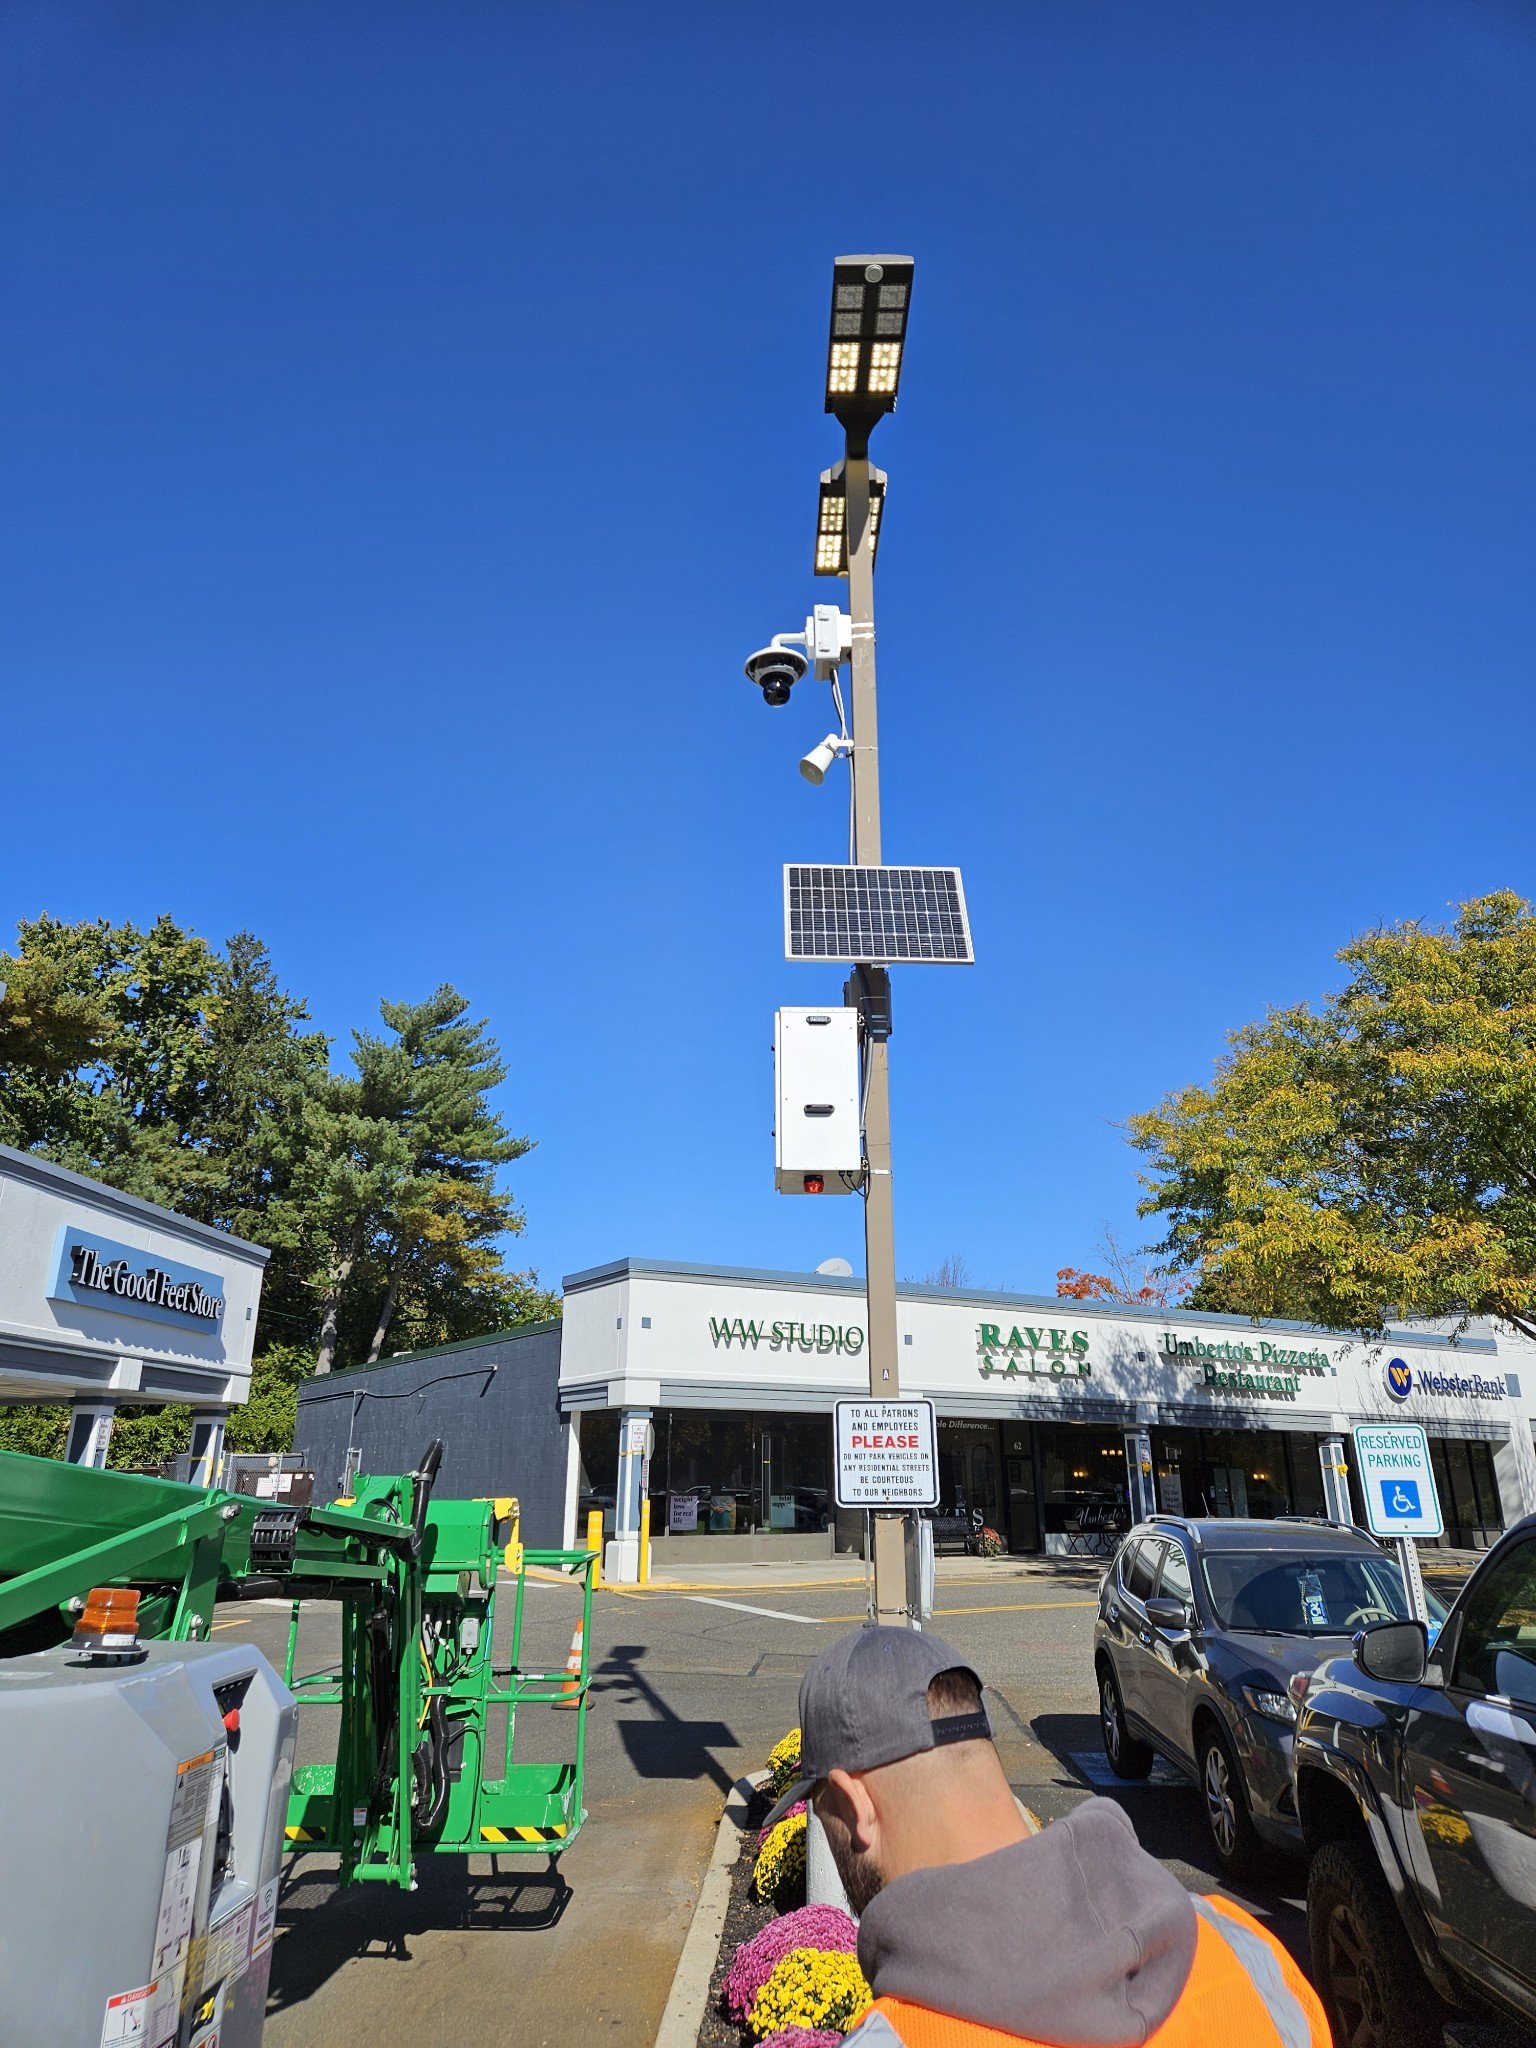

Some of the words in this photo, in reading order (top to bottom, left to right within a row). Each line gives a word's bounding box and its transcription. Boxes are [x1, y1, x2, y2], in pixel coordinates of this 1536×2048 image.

[78, 1247, 112, 1291] The
[114, 1261, 160, 1302] Good
[160, 1273, 192, 1312] Feet
[189, 1283, 223, 1320] Store
[709, 1316, 764, 1344] WW
[771, 1321, 865, 1349] STUDIO
[978, 1322, 1090, 1353] RAVES
[1163, 1332, 1254, 1363] Umberto's
[1259, 1340, 1331, 1368] Pizzeria
[982, 1355, 1092, 1377] SALON
[883, 1369, 890, 1380] A
[1202, 1363, 1302, 1393] Restaurant
[850, 1409, 861, 1418] TO
[864, 1409, 879, 1418] ALL
[881, 1409, 919, 1418] PATRONS
[851, 1422, 868, 1431] AND
[872, 1422, 919, 1431] EMPLOYEES
[948, 1420, 995, 1430] Difference...
[851, 1435, 920, 1449] PLEASE
[1013, 1441, 1022, 1450] 62
[1360, 1435, 1422, 1449] RESERVED
[843, 1453, 851, 1461] DO
[854, 1453, 866, 1461] NOT
[869, 1453, 886, 1461] PARK
[920, 1452, 929, 1460] ON
[1368, 1454, 1422, 1468] PARKING
[843, 1464, 856, 1472] ANY
[859, 1464, 900, 1472] RESIDENTIAL
[902, 1464, 930, 1472] STREETS
[860, 1476, 869, 1484] BE
[872, 1476, 914, 1484] COURTEOUS
[853, 1488, 862, 1496] TO
[864, 1488, 879, 1496] OUR
[882, 1488, 923, 1497] NEIGHBORS
[673, 1509, 682, 1517] for
[1074, 1506, 1127, 1526] Umberto's
